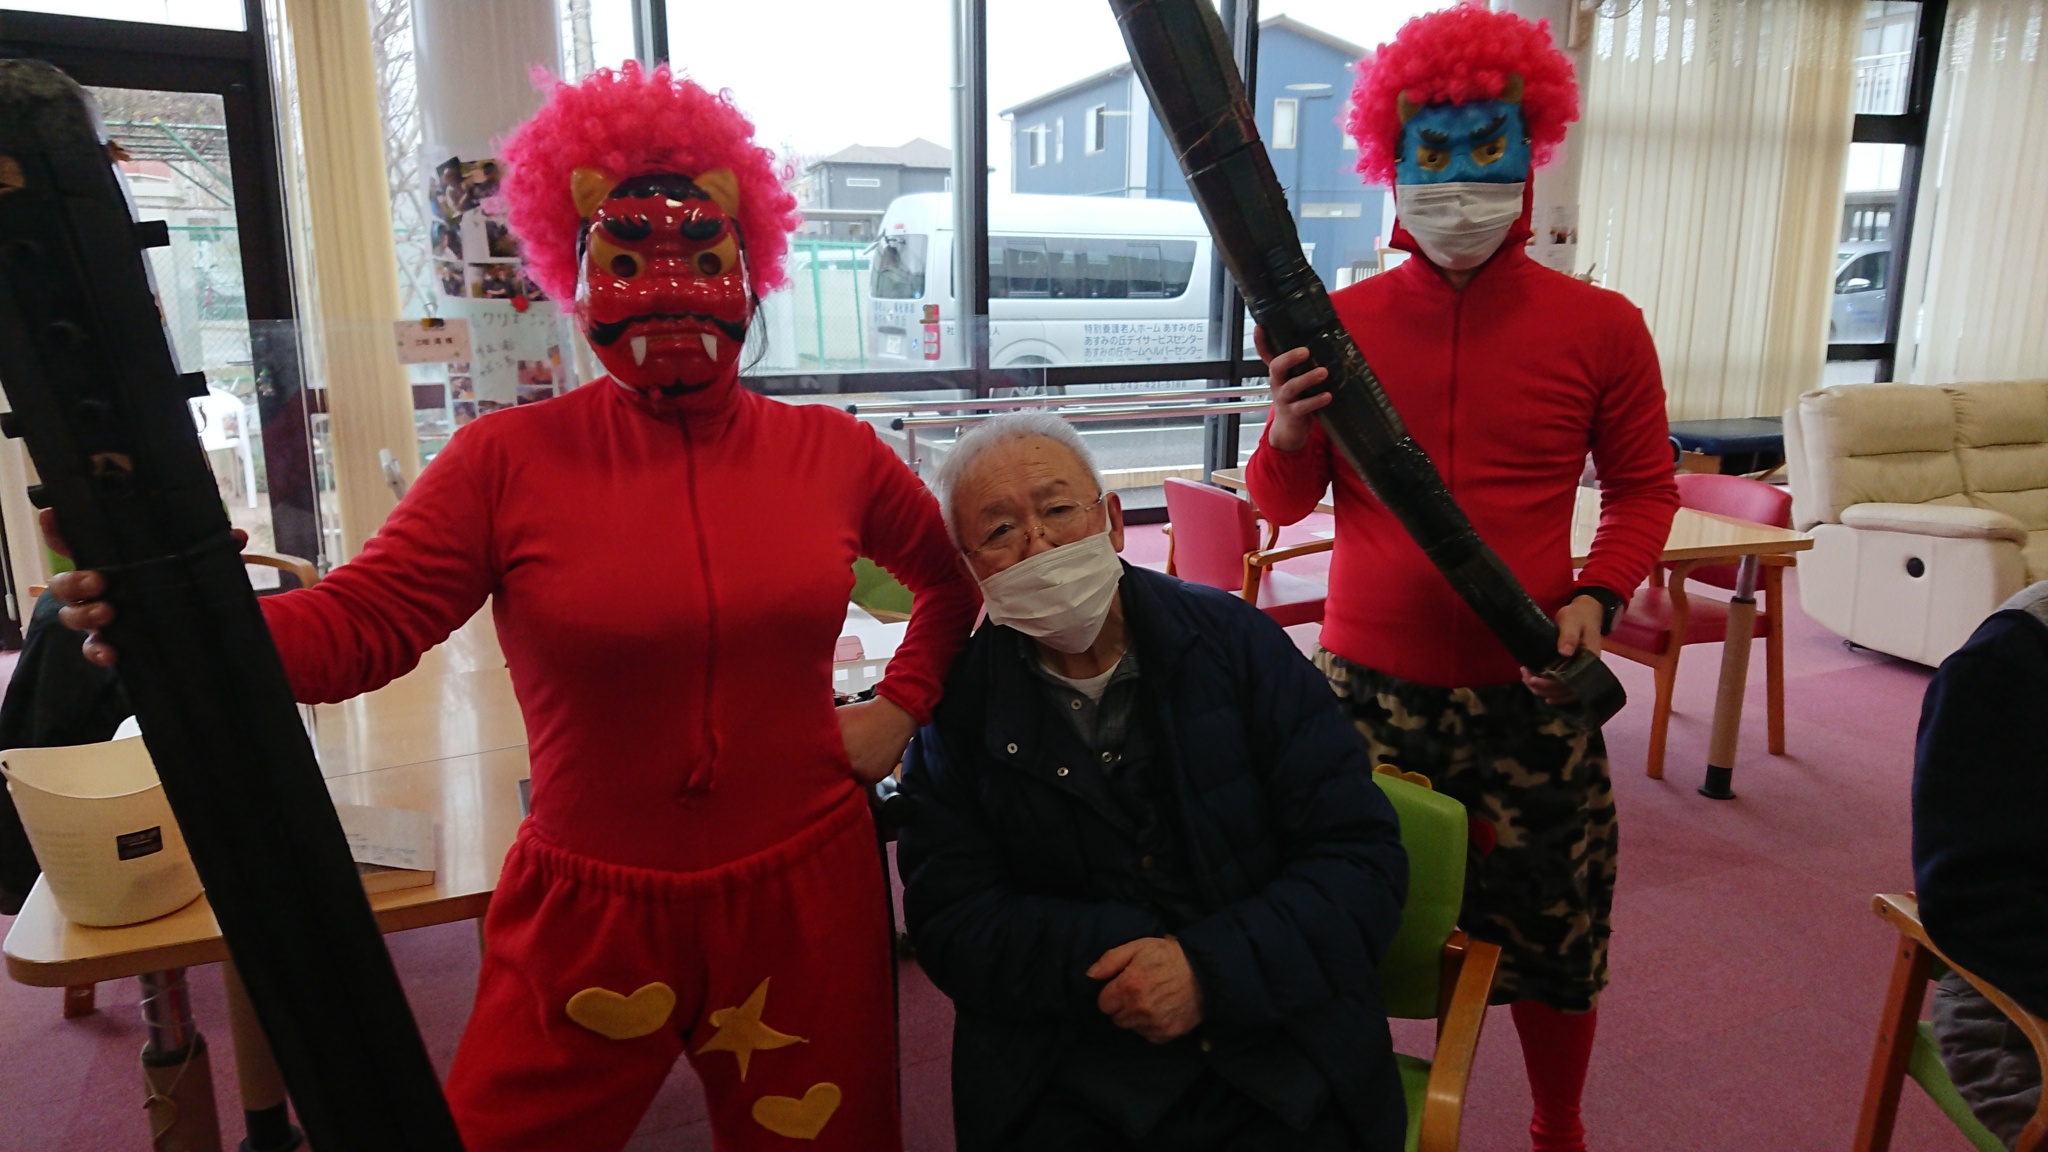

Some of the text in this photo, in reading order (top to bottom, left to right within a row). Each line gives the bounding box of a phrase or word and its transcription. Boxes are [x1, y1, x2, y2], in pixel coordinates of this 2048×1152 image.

[1163, 323, 1203, 333] あすみの丘
